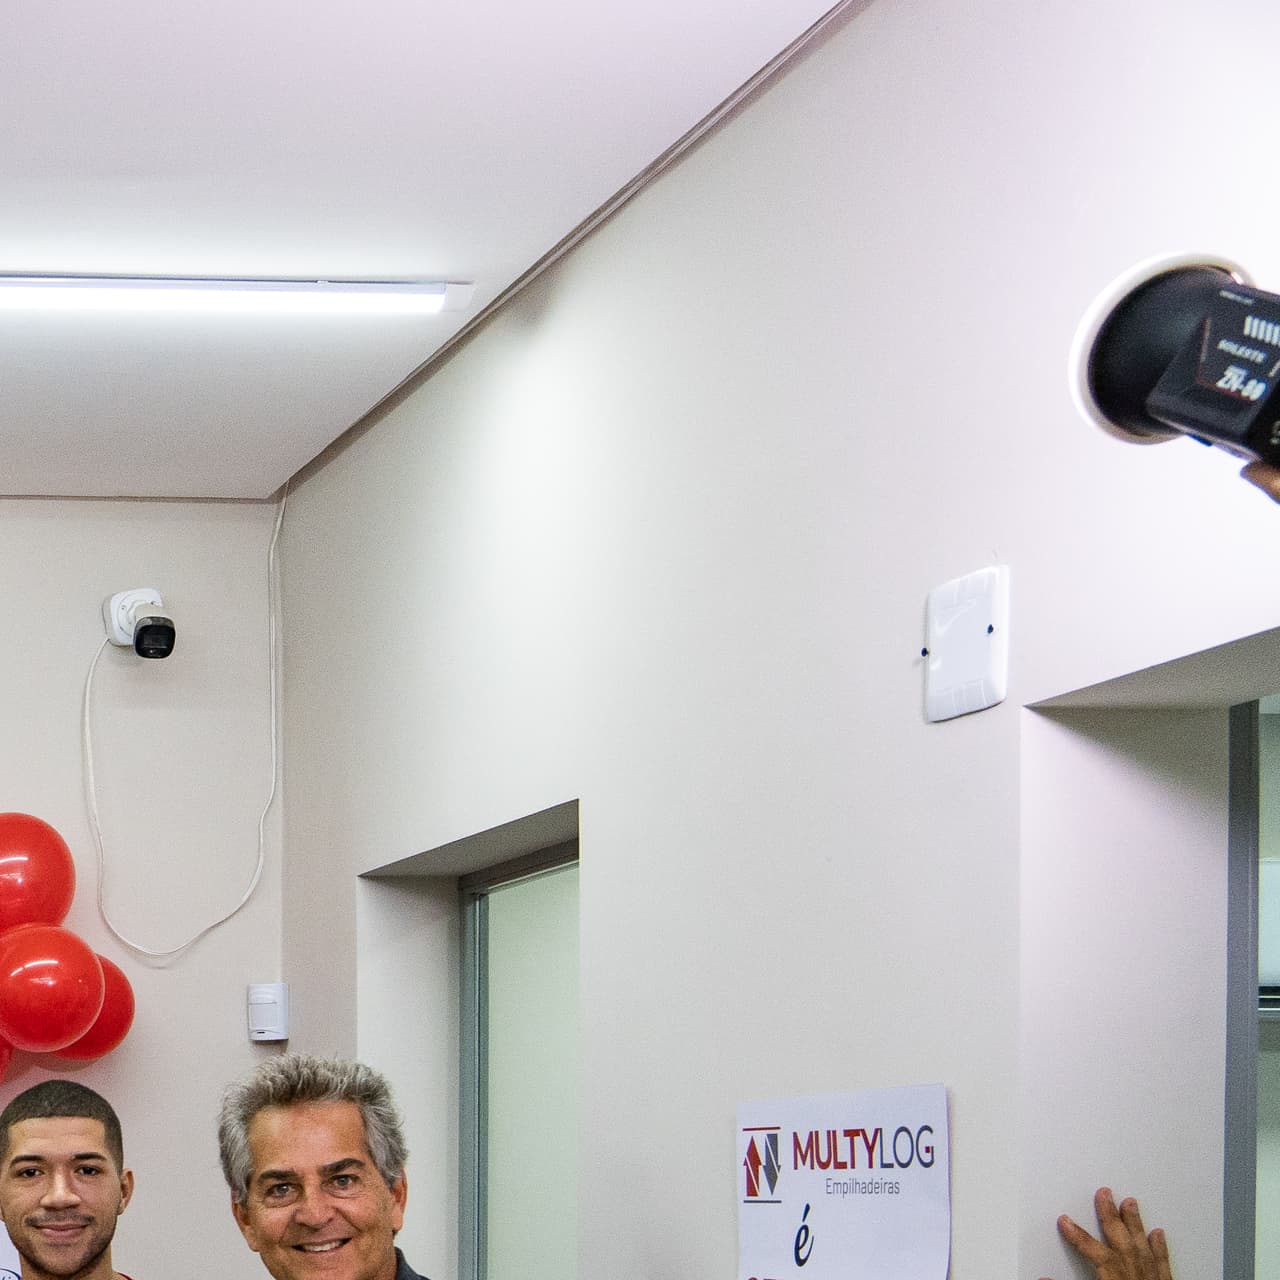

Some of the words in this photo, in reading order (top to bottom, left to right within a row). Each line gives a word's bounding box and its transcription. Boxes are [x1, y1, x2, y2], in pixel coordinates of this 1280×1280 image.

[793, 1125, 935, 1170] MULTYLOG
[825, 1177, 900, 1197] Empilhadeiras
[794, 1203, 815, 1267] é
